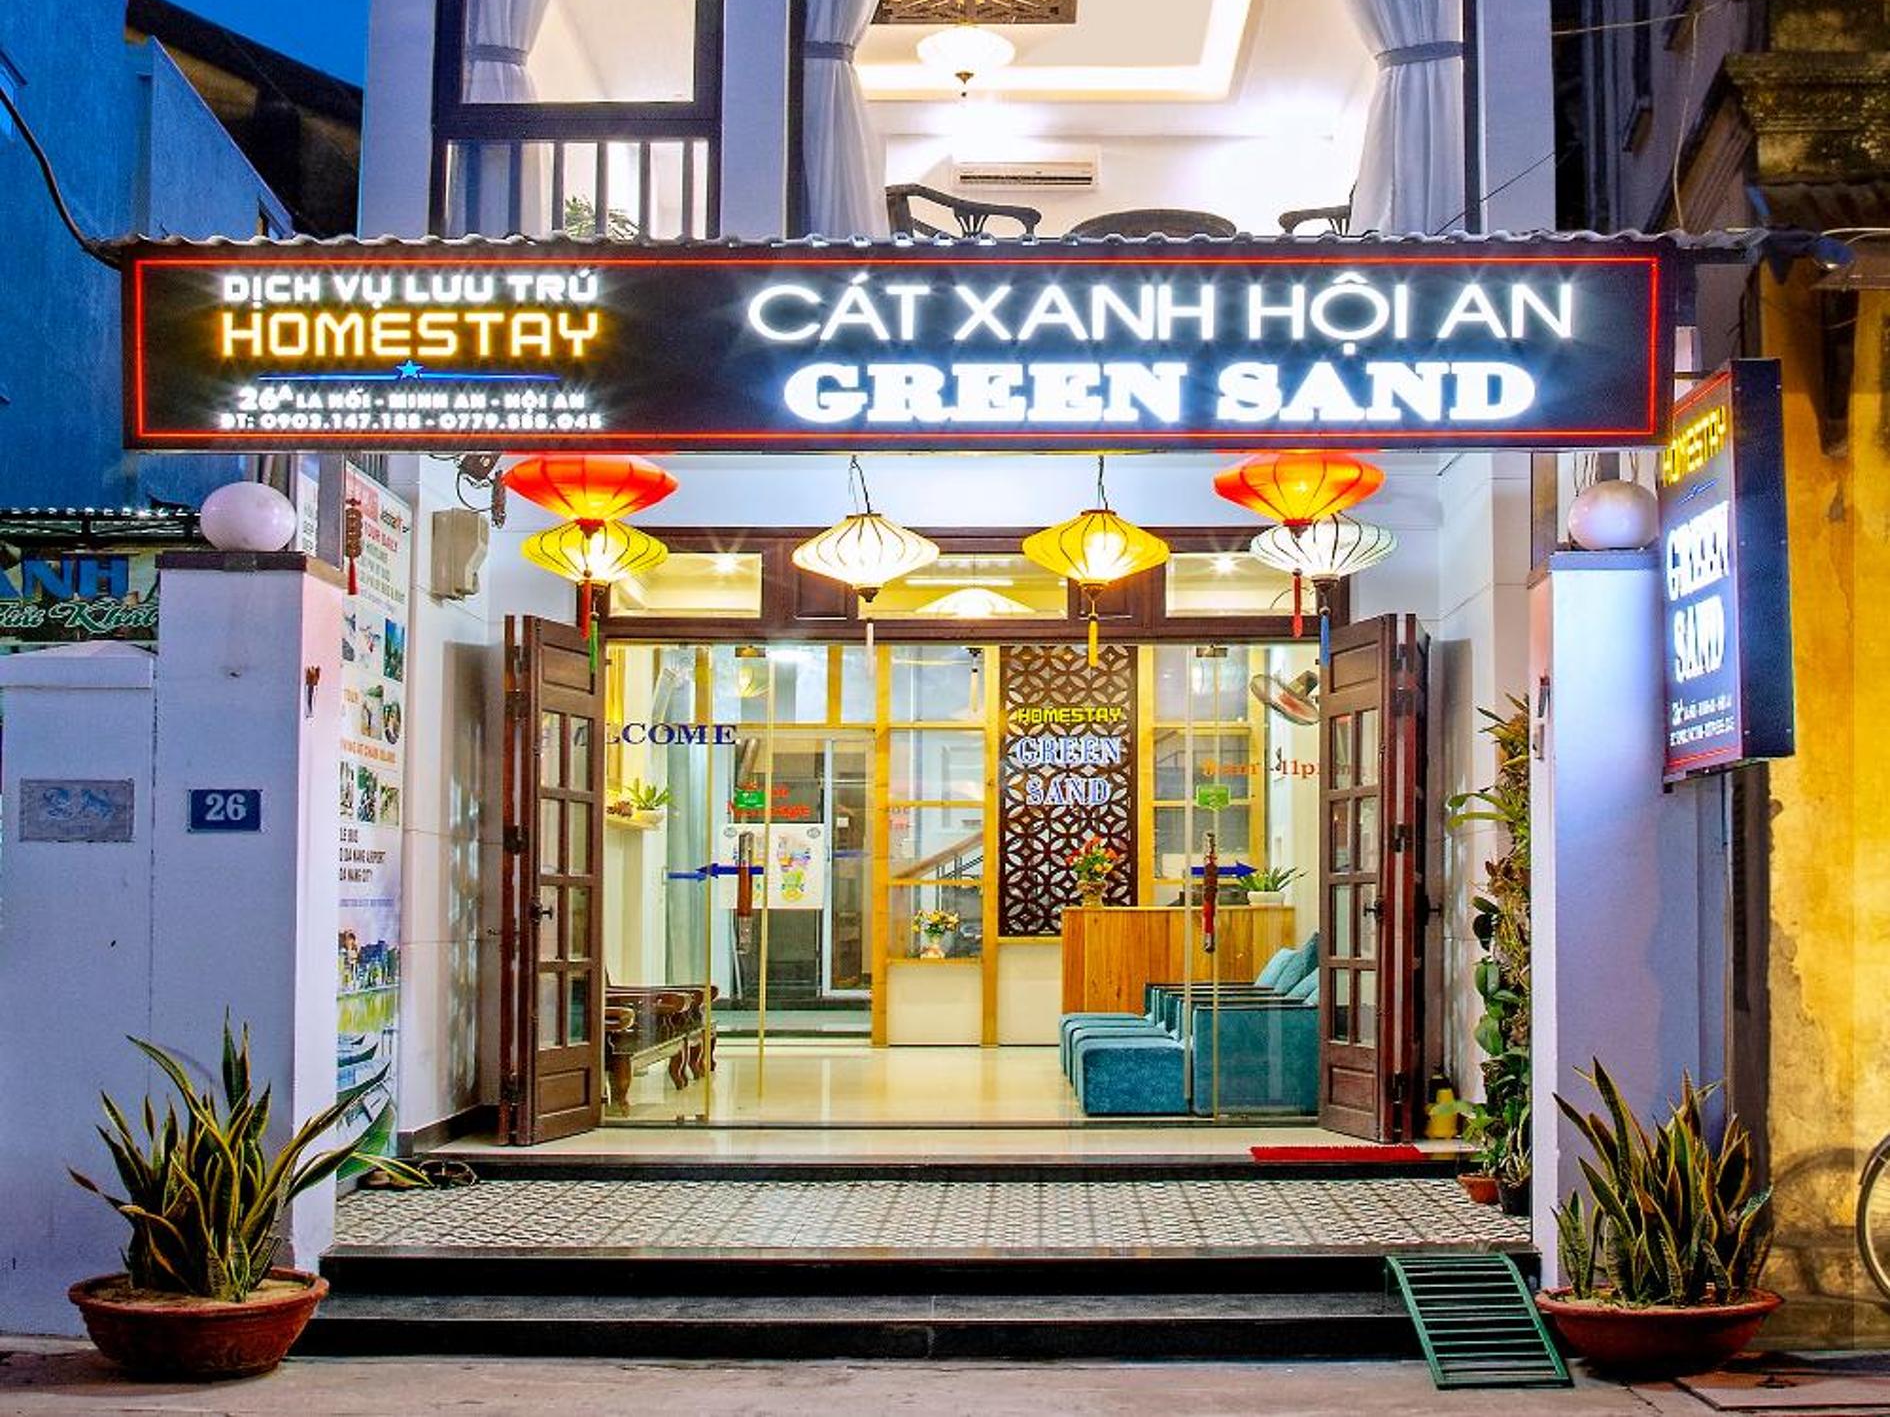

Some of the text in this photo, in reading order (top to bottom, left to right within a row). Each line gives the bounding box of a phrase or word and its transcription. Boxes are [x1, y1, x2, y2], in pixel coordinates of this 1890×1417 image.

[223, 274, 320, 309] DỊCH
[332, 274, 391, 309] VỤ
[506, 268, 598, 302] TRÚ
[222, 310, 599, 357] HOMESTAY
[747, 272, 1573, 355] CÁT XANH HỘI AN
[296, 393, 324, 410] LA
[453, 393, 486, 410] AN
[552, 393, 586, 410] AN
[784, 360, 1536, 424] GREEN SAND
[1662, 405, 1727, 487] HOMESTAY
[1666, 500, 1730, 601] GREEN
[1673, 595, 1726, 684] SAND
[1016, 707, 1124, 724] HOMESTAY
[1015, 735, 1123, 766] GREEN
[204, 792, 247, 822] 26
[1026, 777, 1112, 806] SAND
